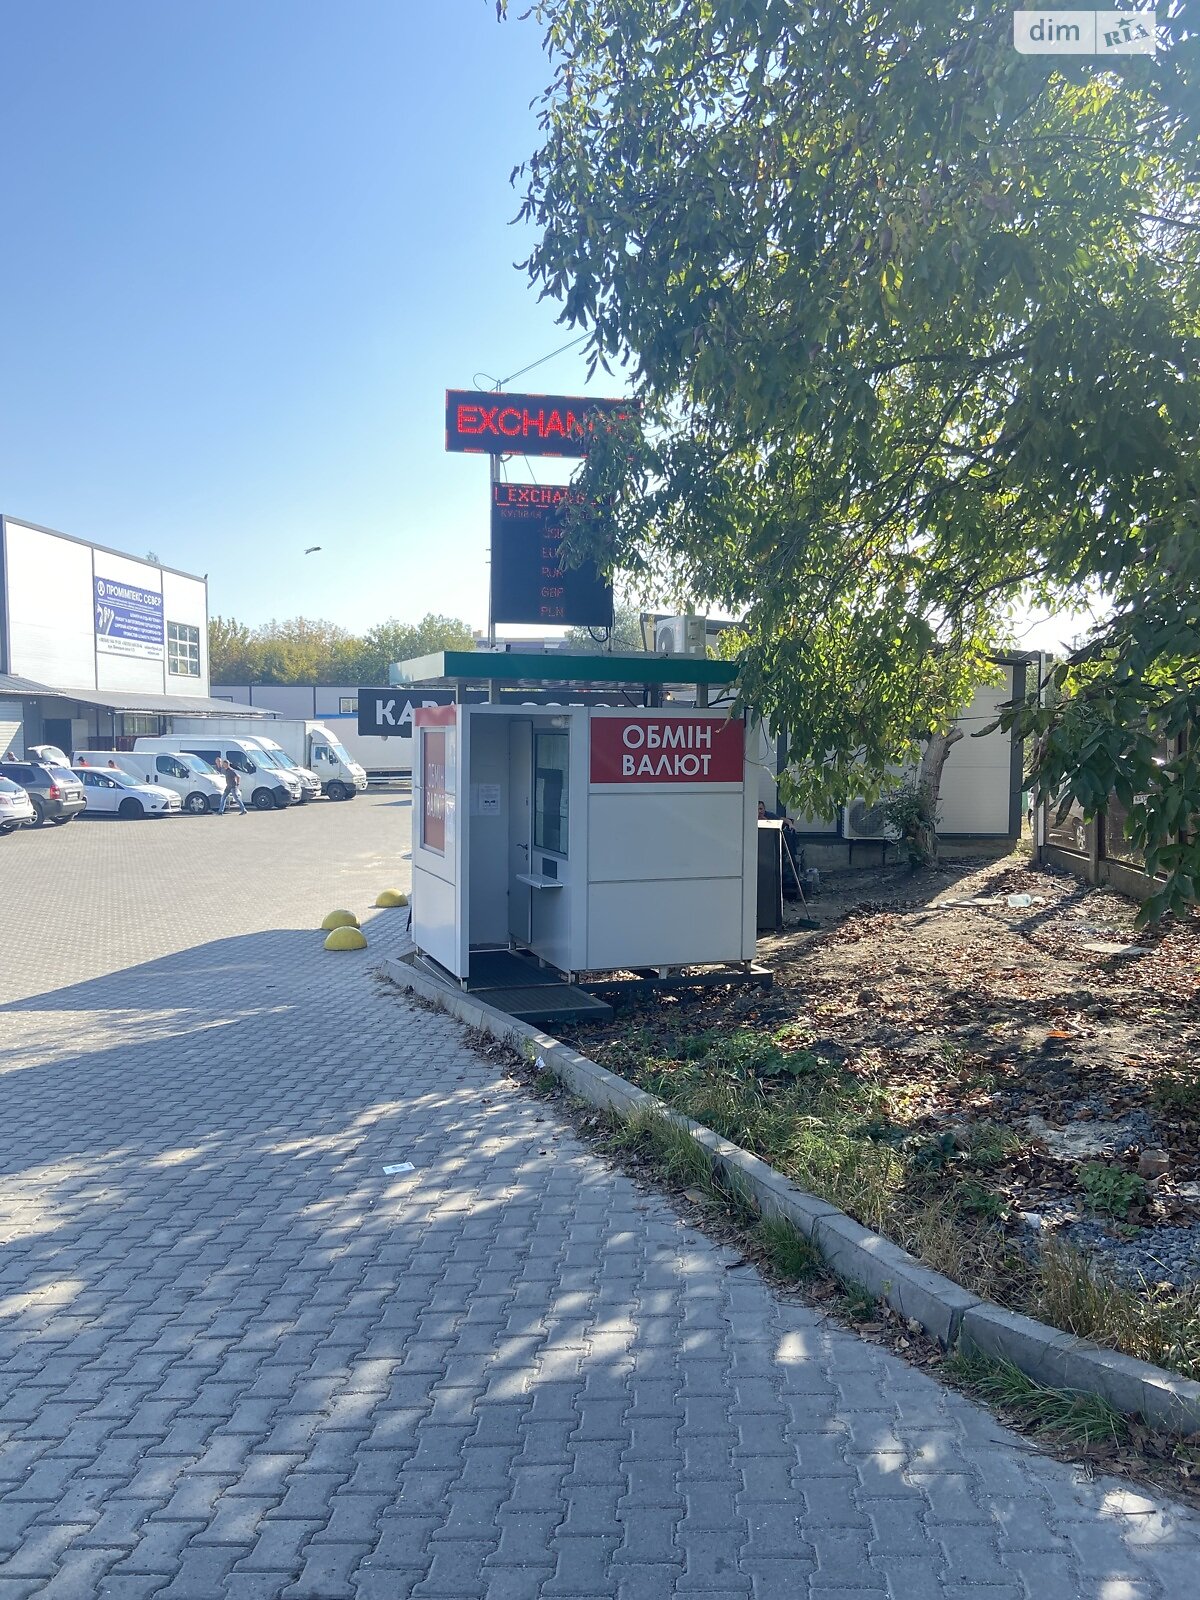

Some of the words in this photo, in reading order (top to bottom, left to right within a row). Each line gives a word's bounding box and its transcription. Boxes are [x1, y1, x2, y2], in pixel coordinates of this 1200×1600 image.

[457, 404, 630, 441] EXCHAN
[542, 547, 562, 558] EU
[622, 724, 712, 749] ОБМІН
[622, 753, 712, 777] ВАЛЮТ
